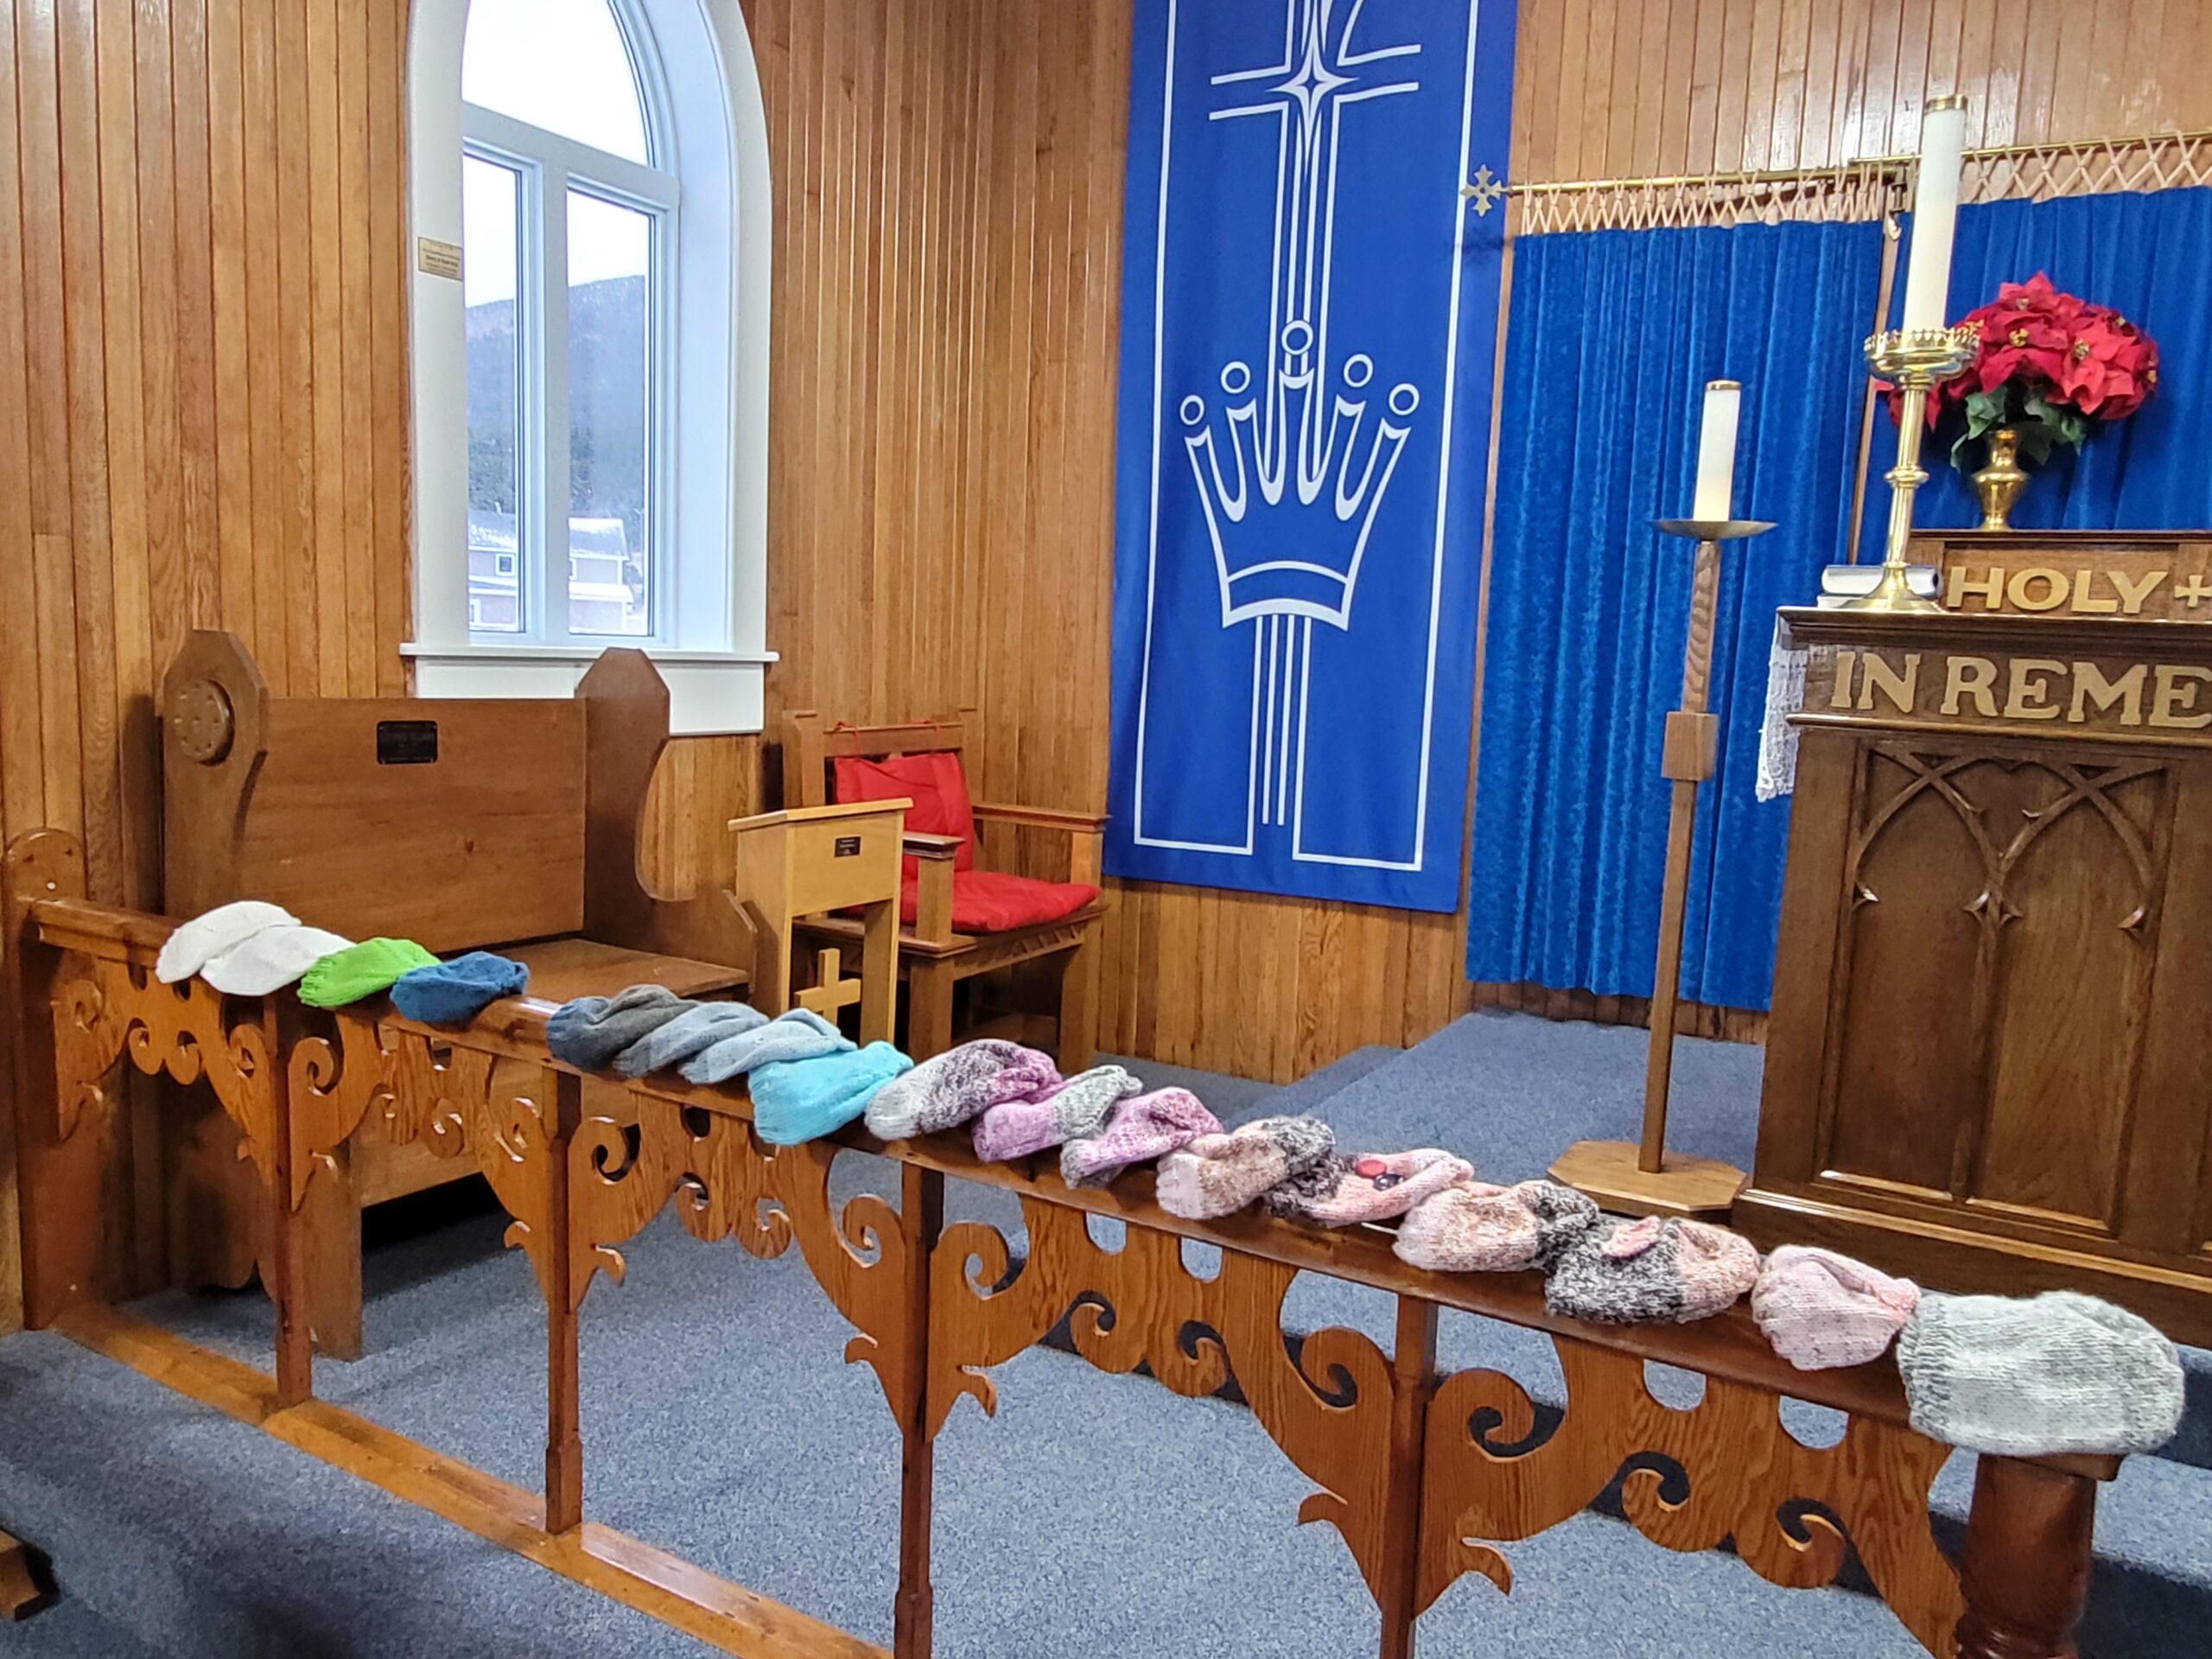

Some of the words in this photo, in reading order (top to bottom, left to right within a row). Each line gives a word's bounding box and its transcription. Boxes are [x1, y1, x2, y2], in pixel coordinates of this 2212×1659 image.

[1946, 566, 2168, 614] HOLY
[1830, 651, 1921, 714] IN
[1940, 656, 2212, 729] REME
